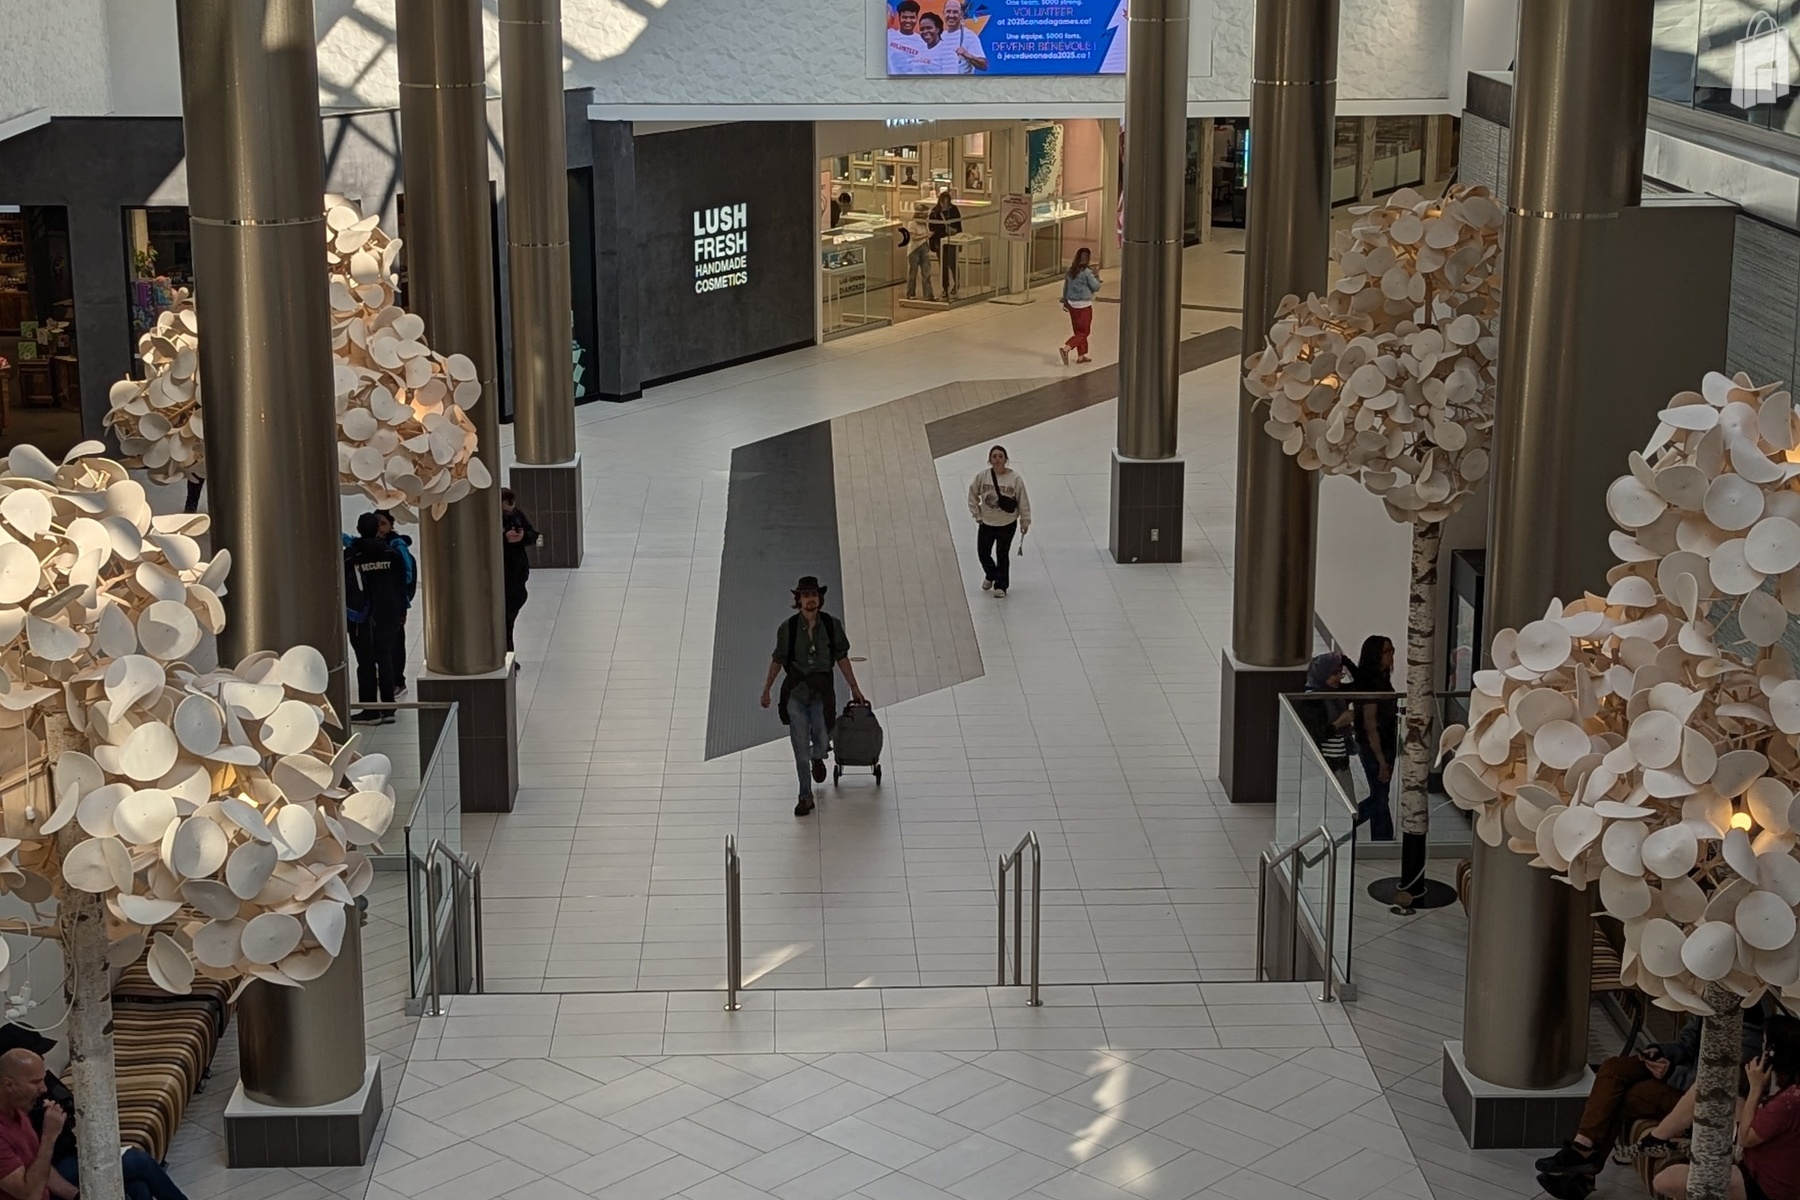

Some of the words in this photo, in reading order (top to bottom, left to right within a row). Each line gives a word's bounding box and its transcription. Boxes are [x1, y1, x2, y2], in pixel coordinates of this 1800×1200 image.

[1013, 7, 1074, 16] VOLUNTEER
[1007, 17, 1092, 26] 2025canadagames.ca!
[991, 42, 1035, 51] DEVENIR
[1003, 52, 1086, 61] jeuxducanada2025.ca
[693, 202, 748, 237] LUSH
[694, 230, 748, 262] FRESH
[695, 255, 748, 278] HANDMADE
[695, 271, 748, 294] COSMETICS
[360, 561, 392, 572] SECURITY
